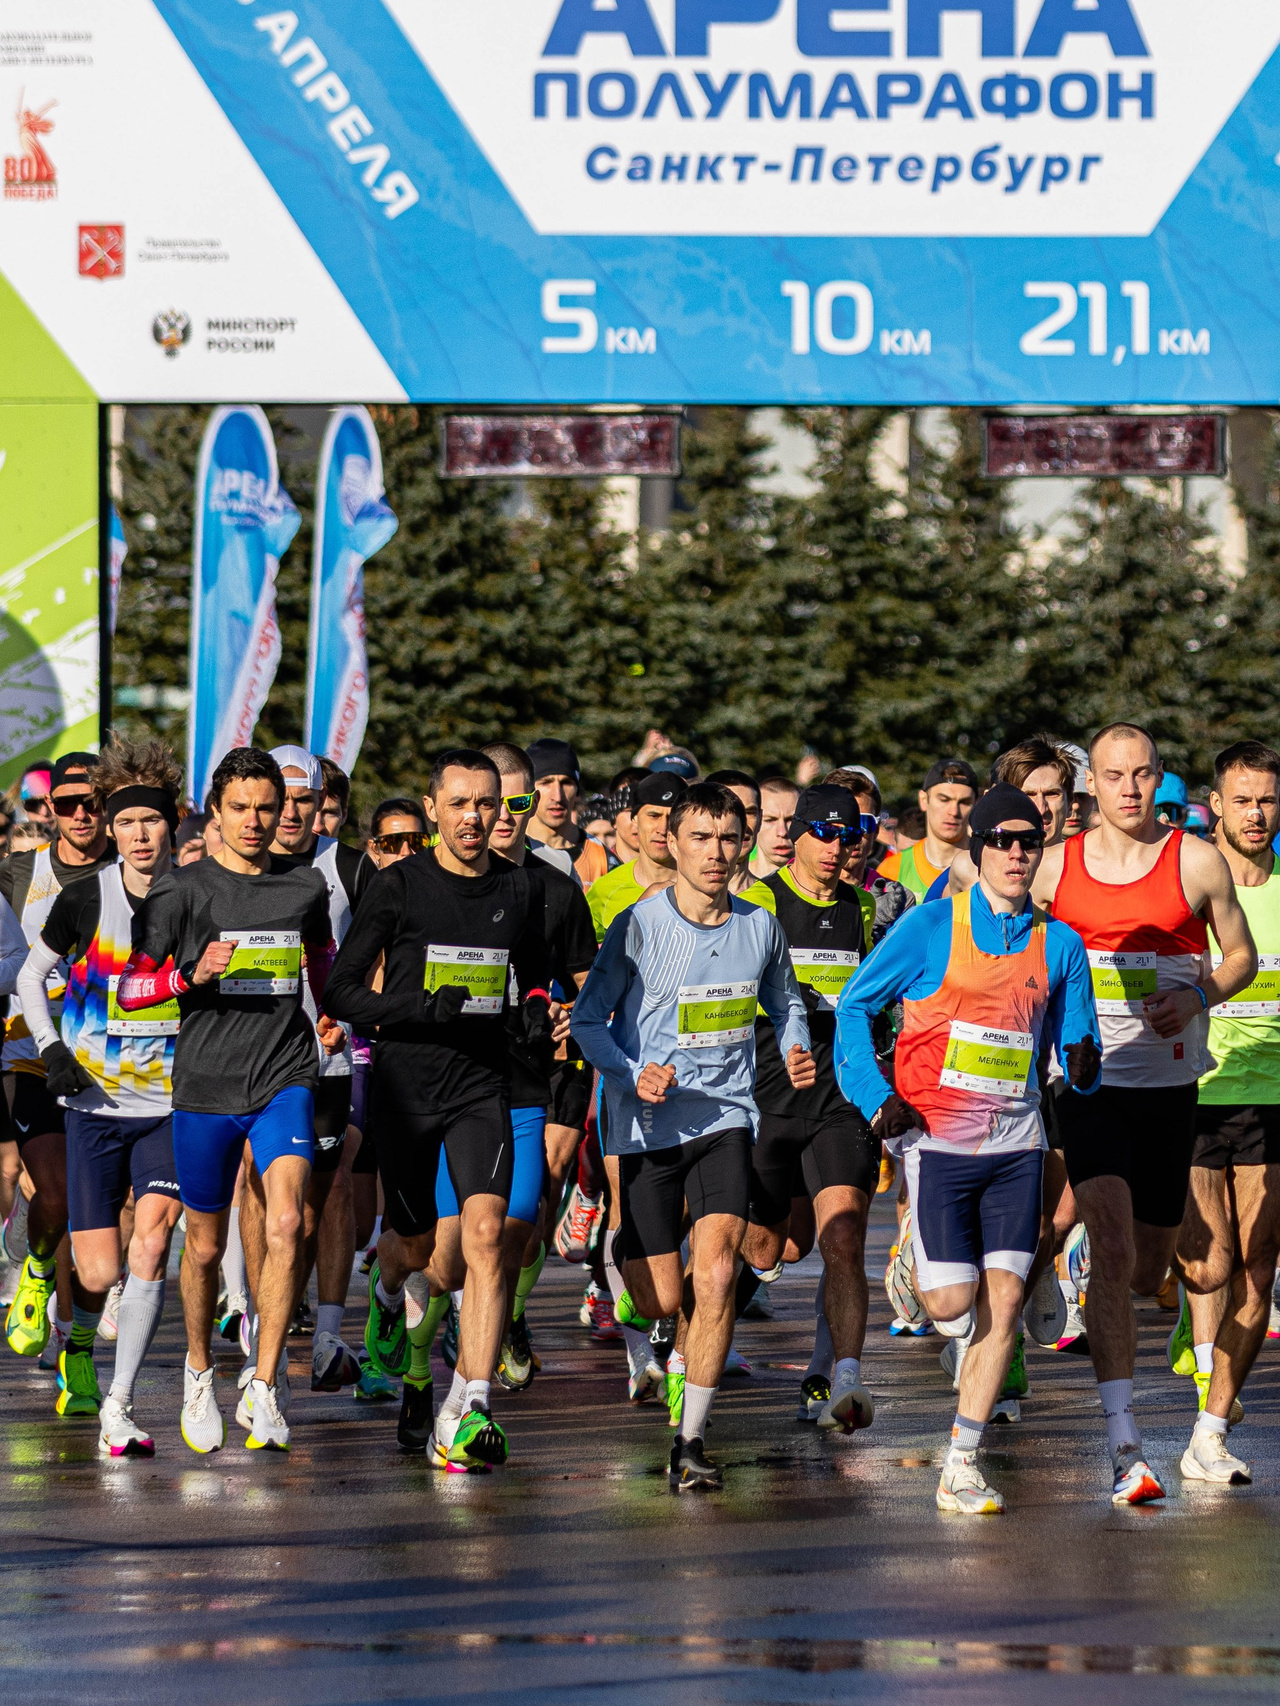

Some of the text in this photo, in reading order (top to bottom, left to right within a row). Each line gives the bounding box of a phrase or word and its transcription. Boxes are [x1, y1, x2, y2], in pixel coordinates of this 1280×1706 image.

[532, 71, 1156, 120] ПОЛУМАРАФОН
[254, 10, 419, 219] АПРЕЛЯ
[4, 157, 33, 183] 80
[584, 143, 1103, 194] Санкт-Петербург
[541, 280, 656, 355] 5 КМ
[781, 280, 931, 355] 10 КМ
[1020, 280, 1211, 365] 21,1 КМ
[207, 318, 296, 331] МИНСПОРТ
[207, 339, 275, 351] РОССИИ
[253, 959, 288, 967] МАТВЕЕВ
[453, 975, 498, 984] РАМАЗАНОВ
[809, 975, 851, 983] ХОРОШИЛО
[1100, 979, 1143, 988] ЗИНОВЬЕВ
[704, 1008, 749, 1020] КАНЫБЕКОВ
[978, 1056, 1020, 1068] МЕЛЕНЧУК
[148, 1180, 180, 1191] INSAN
